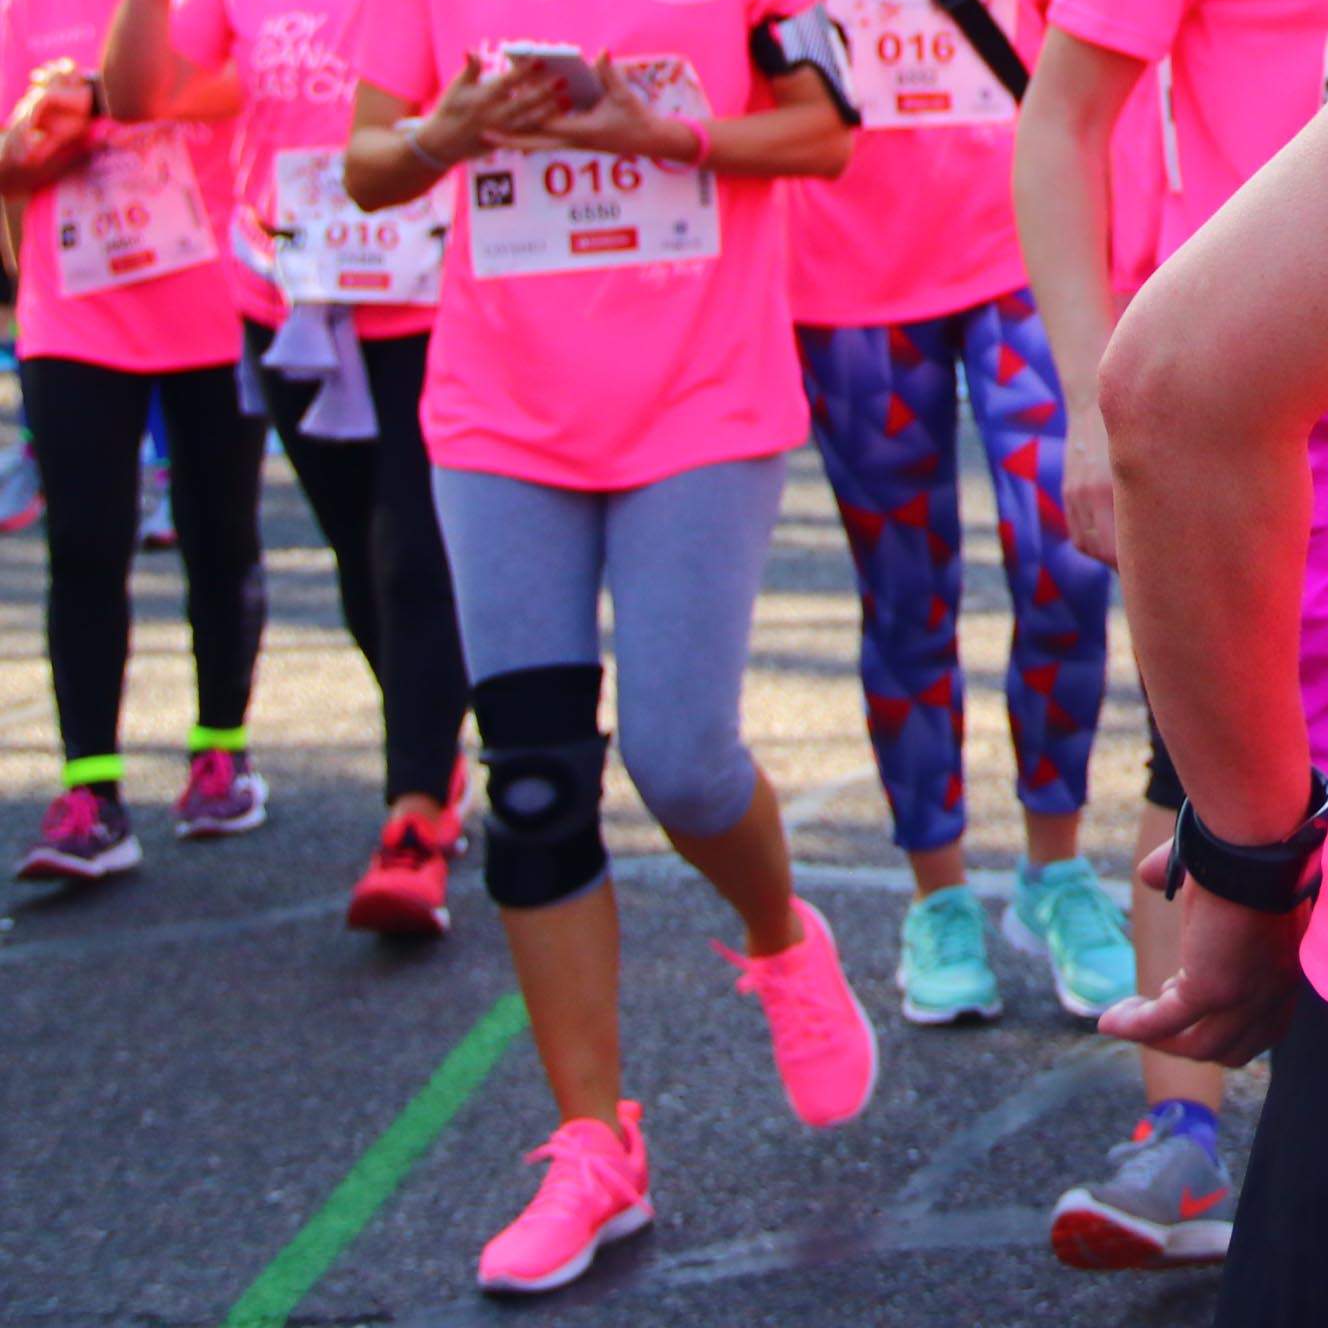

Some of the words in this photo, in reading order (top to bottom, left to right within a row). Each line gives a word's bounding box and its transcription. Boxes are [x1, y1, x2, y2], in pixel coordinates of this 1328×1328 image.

[876, 31, 956, 66] 016
[543, 154, 643, 198] 016
[90, 200, 151, 240] 016
[324, 222, 400, 253] 016
